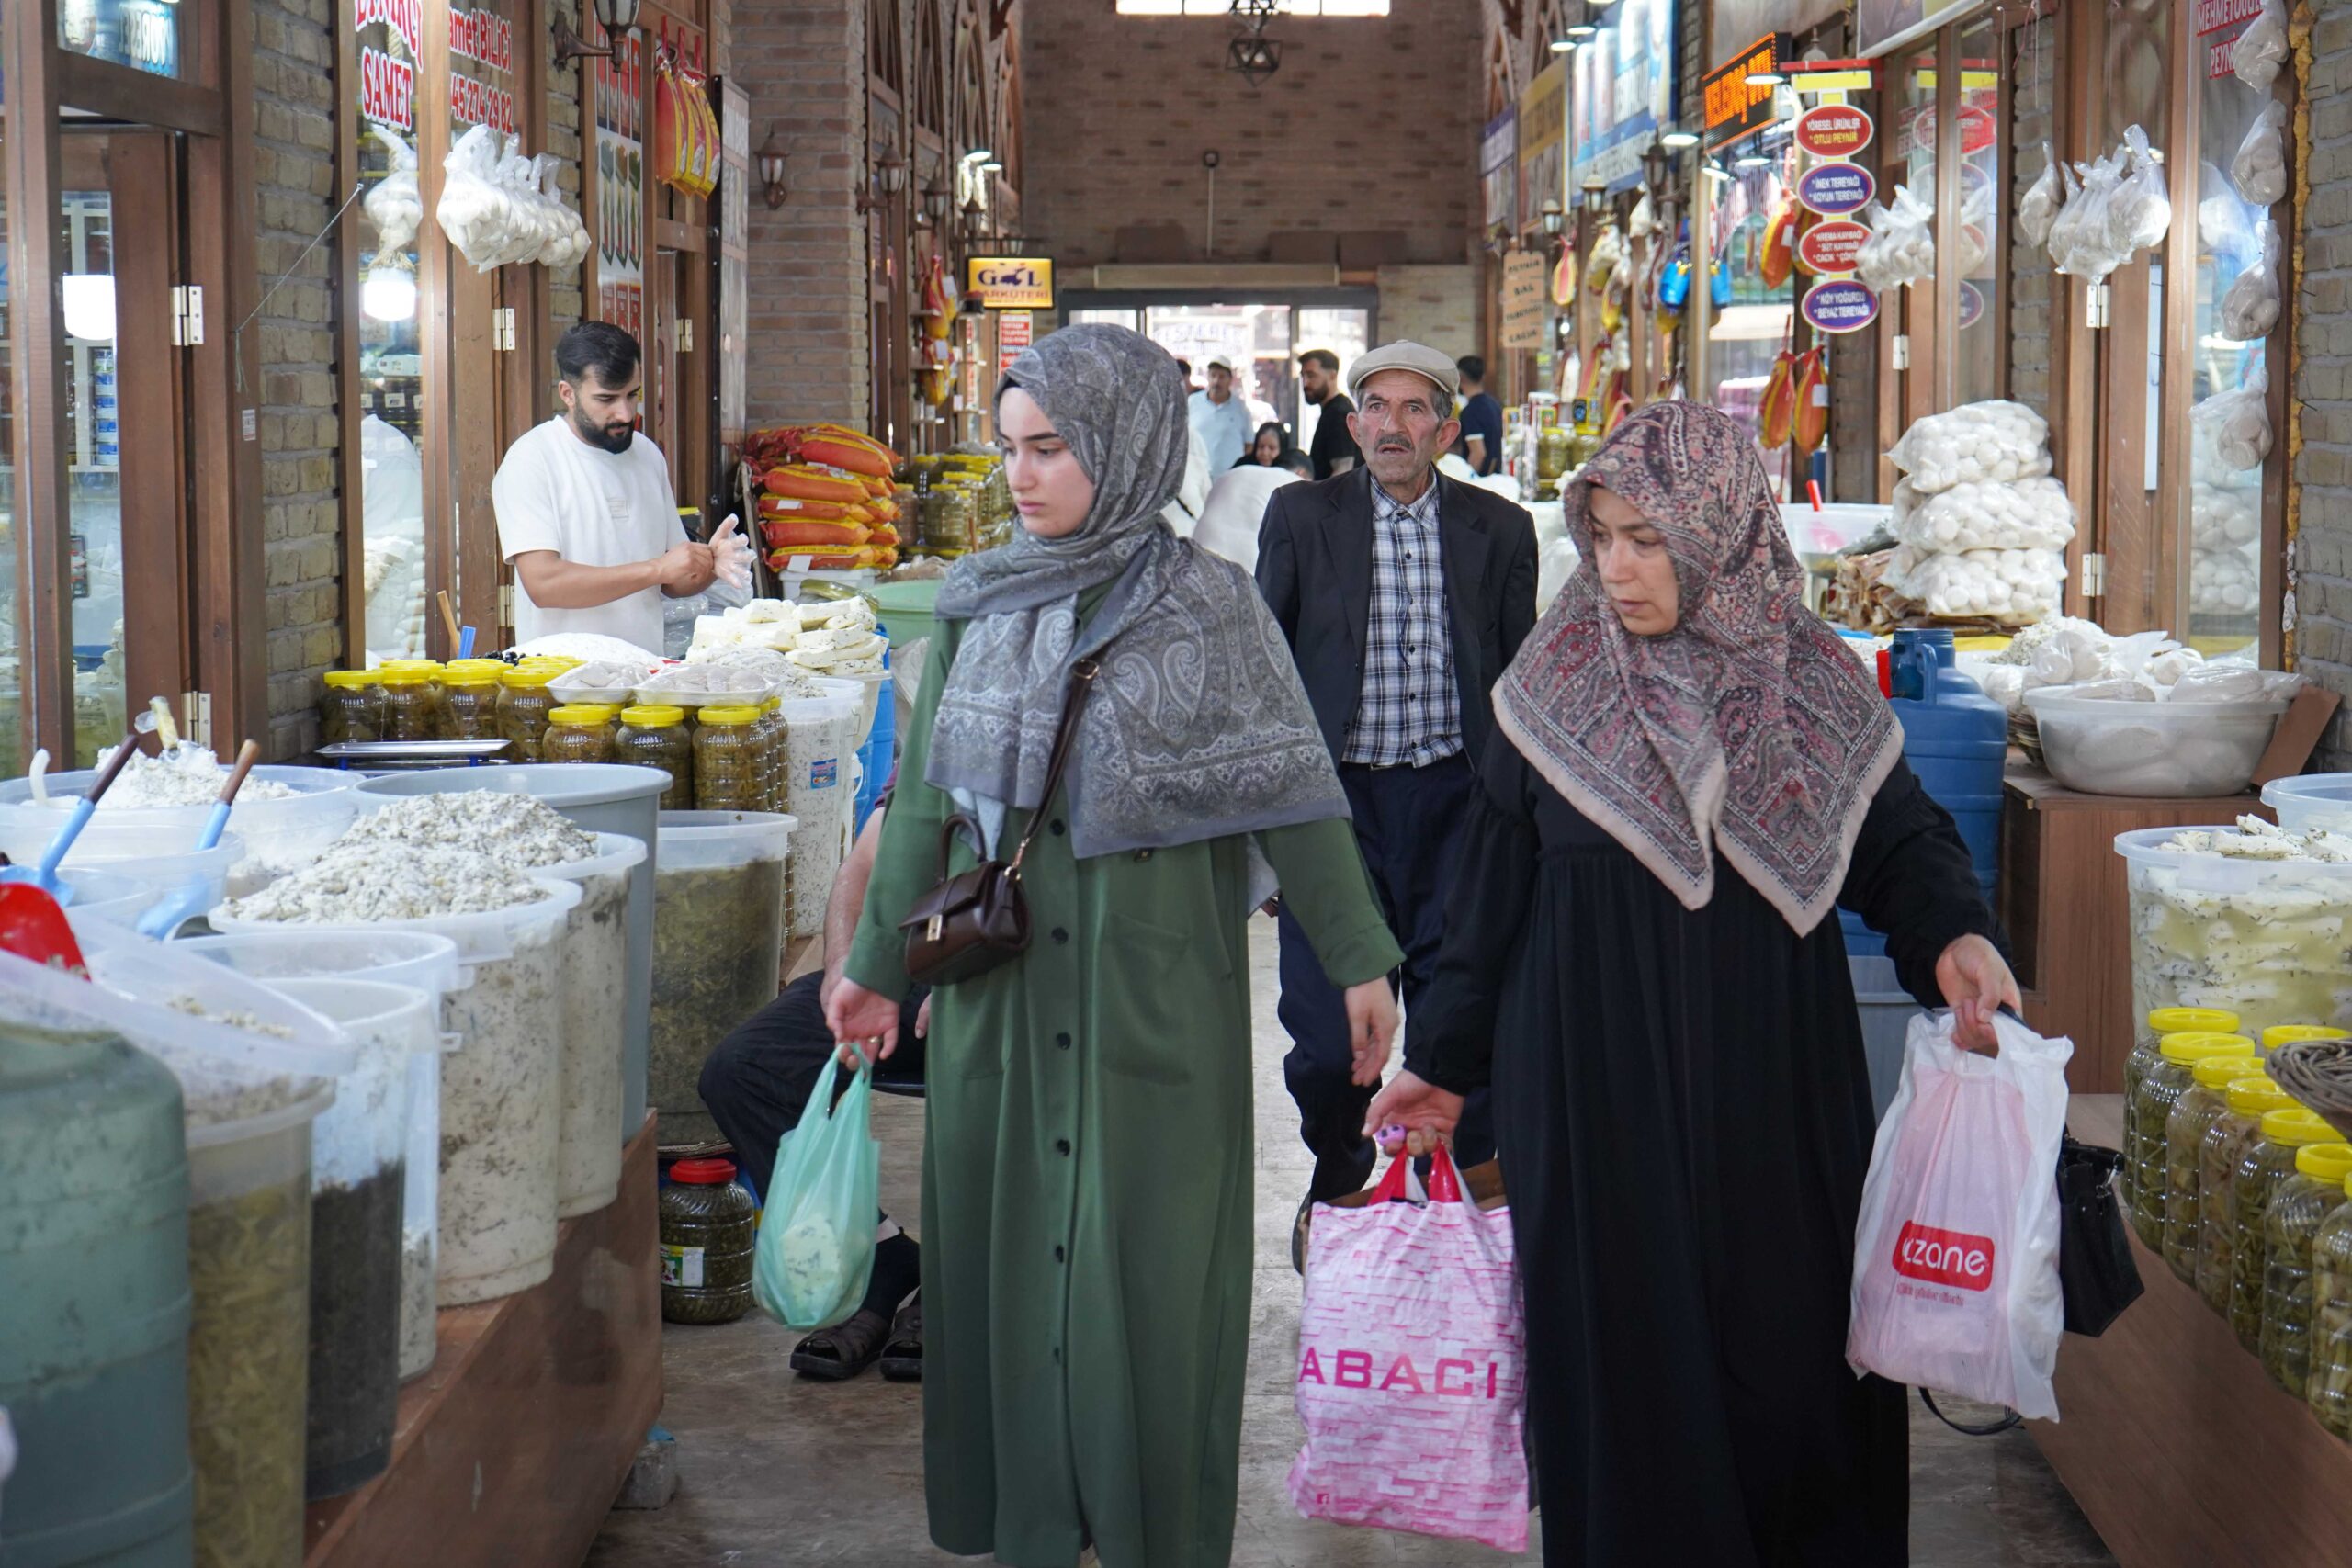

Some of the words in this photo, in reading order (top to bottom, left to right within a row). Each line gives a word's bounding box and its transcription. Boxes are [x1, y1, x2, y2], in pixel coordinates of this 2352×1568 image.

[362, 47, 413, 130] SAMET
[467, 78, 485, 125] 274
[487, 85, 499, 133] 29
[501, 90, 513, 136] 82
[1807, 118, 1833, 130] YÖRESEL
[1833, 117, 1861, 130] ÜRÜNLER
[1813, 133, 1832, 144] OTLU
[1832, 131, 1858, 143] PEYNİR
[1815, 176, 1831, 189] İNEK
[1831, 175, 1860, 187] TEREYAĞI
[1813, 190, 1835, 203] KOYUN
[1835, 188, 1864, 201] TEREYAĞI
[1820, 291, 1835, 305] KÖY
[1298, 1346, 1498, 1399] ABACI
